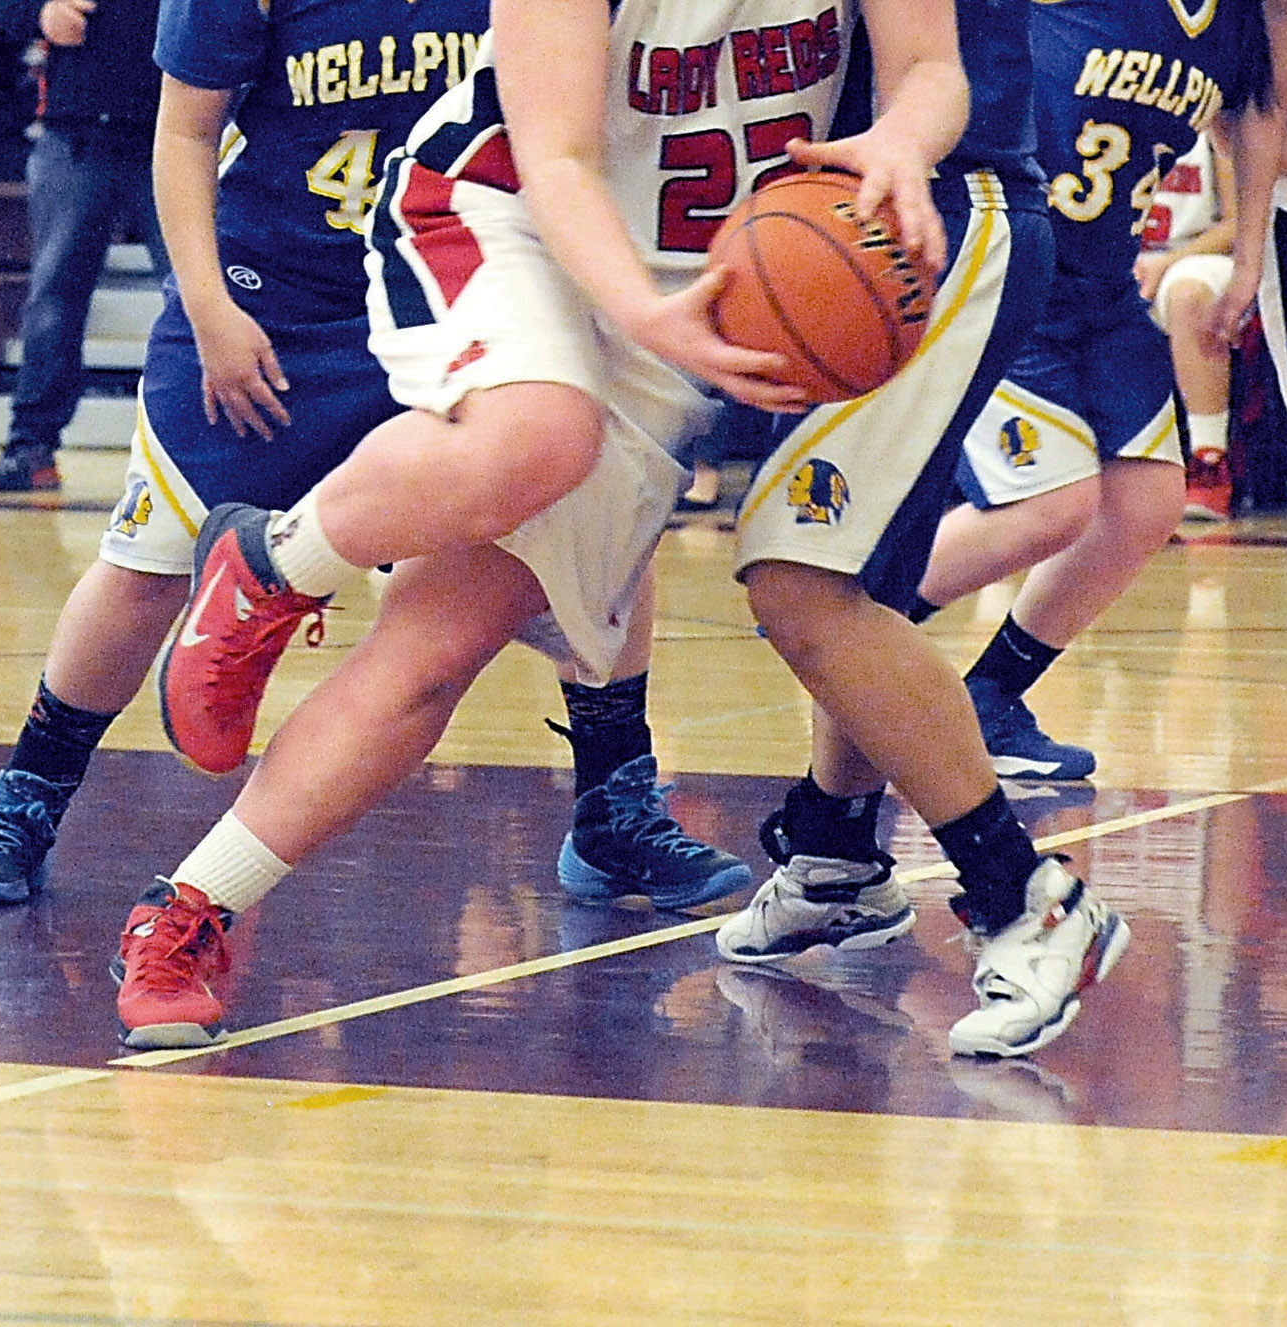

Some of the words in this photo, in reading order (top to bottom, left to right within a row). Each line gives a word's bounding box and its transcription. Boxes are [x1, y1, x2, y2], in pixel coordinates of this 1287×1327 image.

[628, 36, 726, 115] LADY
[730, 6, 840, 101] REDS
[1074, 48, 1224, 132] WELLPI
